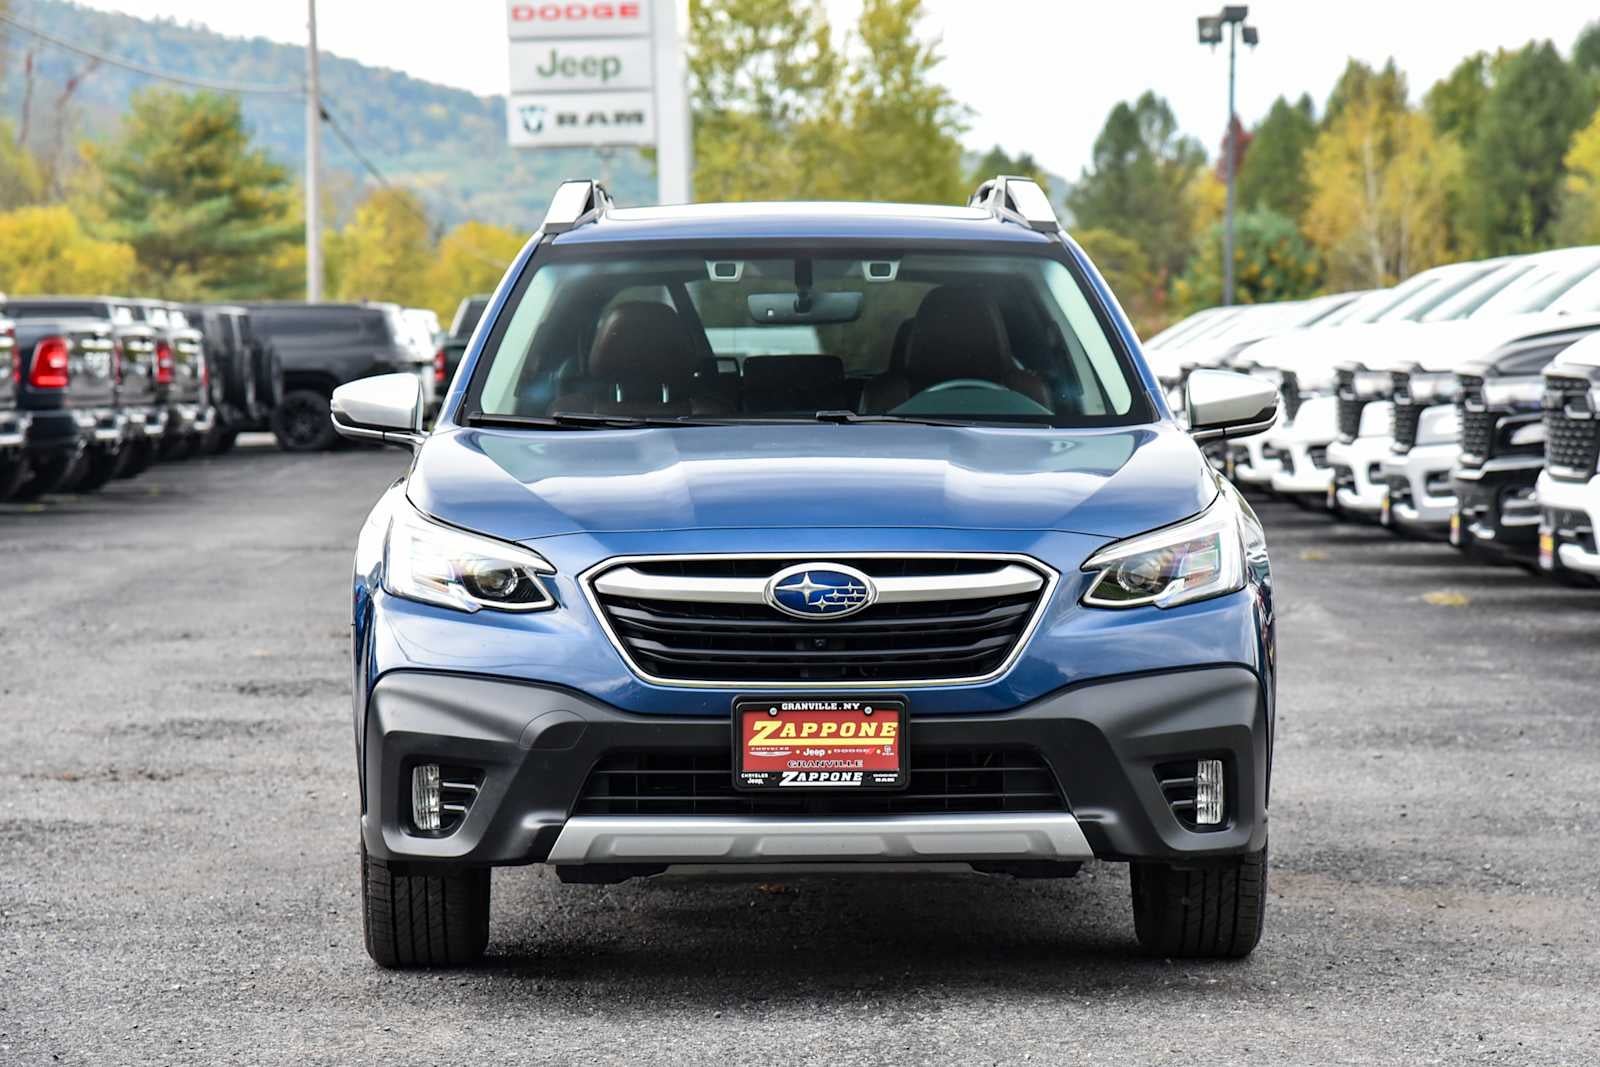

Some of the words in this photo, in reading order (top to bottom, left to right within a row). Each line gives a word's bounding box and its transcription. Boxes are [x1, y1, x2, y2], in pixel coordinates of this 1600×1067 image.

[511, 2, 640, 22] DODGE
[536, 48, 622, 82] Jeep
[556, 109, 645, 127] RAM
[843, 702, 861, 710] NY
[748, 720, 898, 746] ZAPPONE
[803, 747, 826, 757] Jeep
[787, 759, 864, 769] GRANVILLE
[779, 771, 864, 787] ZAPPONE
